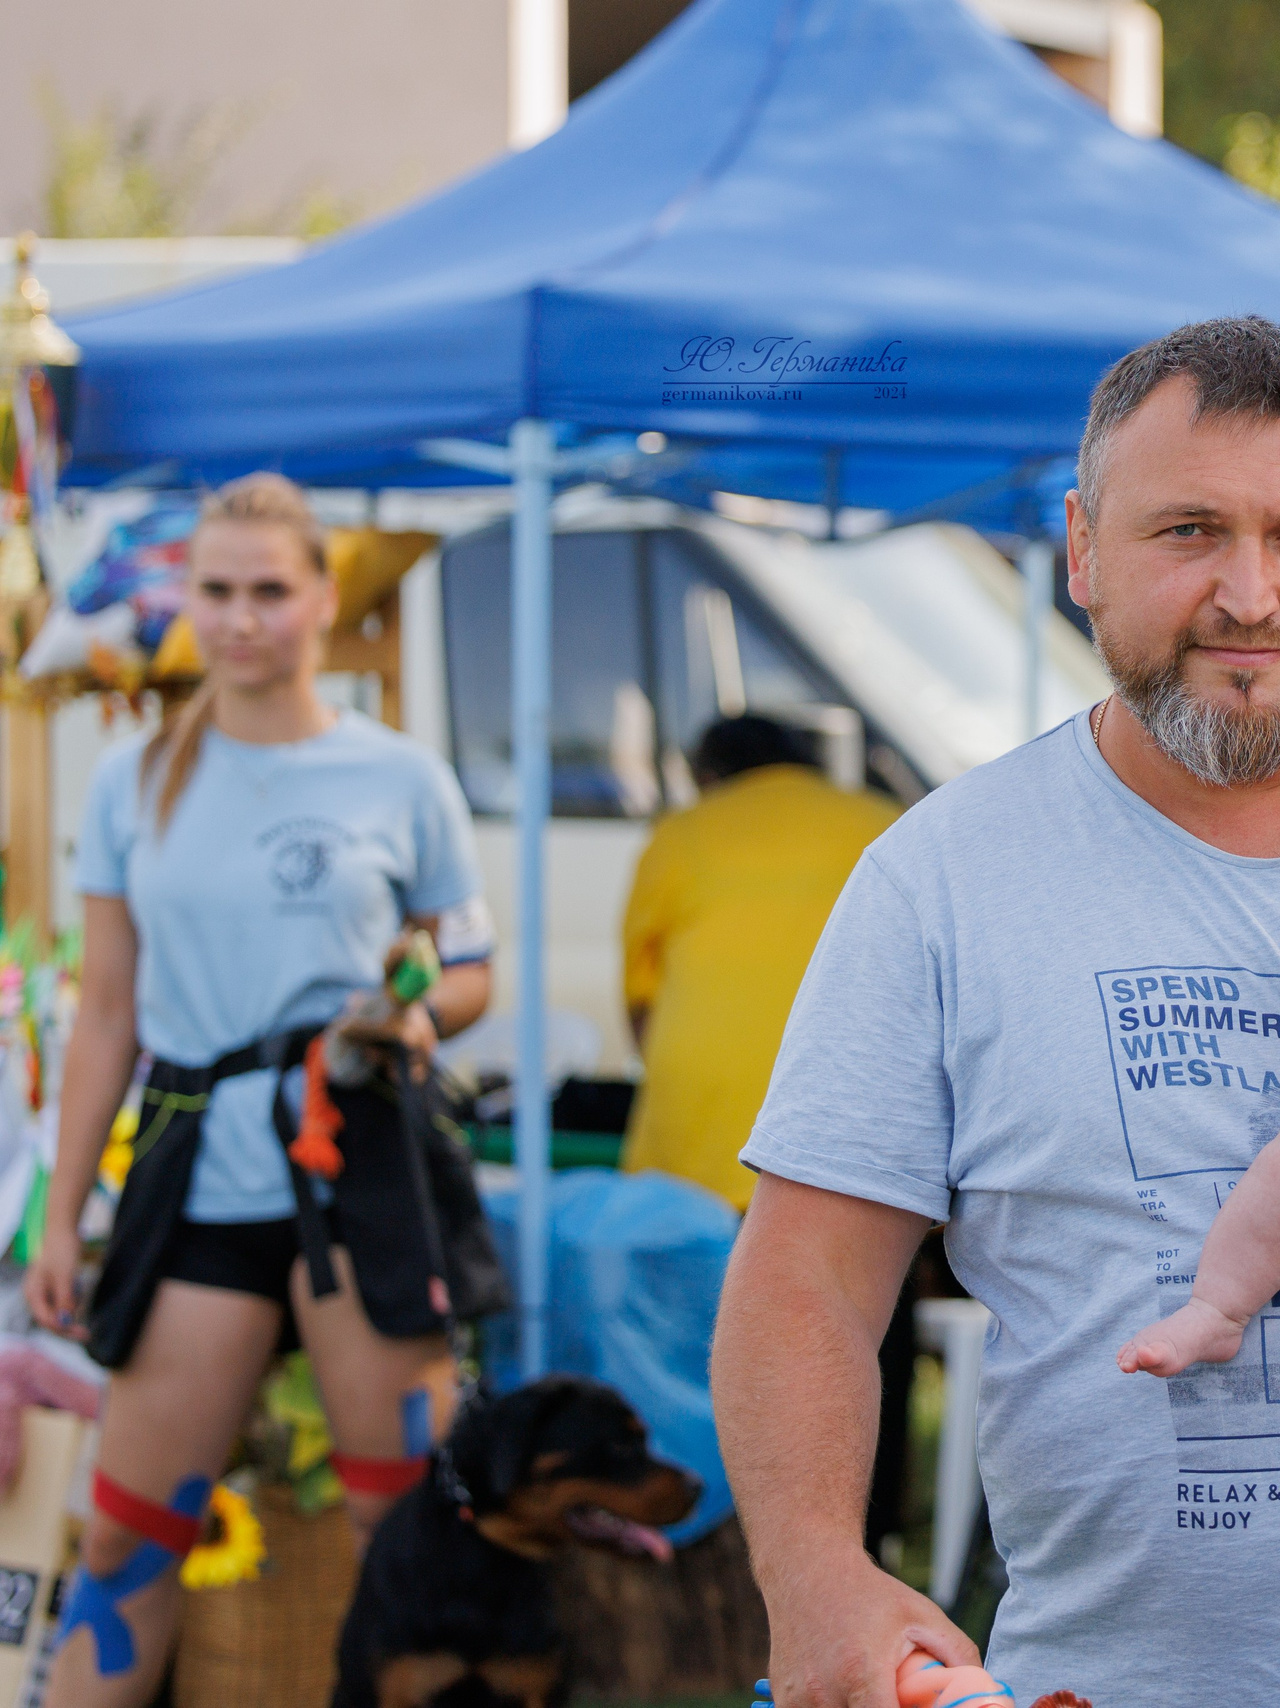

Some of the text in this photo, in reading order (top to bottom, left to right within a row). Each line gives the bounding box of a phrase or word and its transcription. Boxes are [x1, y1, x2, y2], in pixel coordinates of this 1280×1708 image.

[1111, 975, 1240, 1003] SPEND
[1120, 1030, 1221, 1061] WITH
[1137, 1189, 1158, 1199] WE
[1140, 1201, 1167, 1212] TRA
[1156, 1248, 1180, 1259] NOT
[1156, 1262, 1171, 1271] TO
[1177, 1483, 1258, 1503] RELAX
[1177, 1510, 1252, 1530] ENJOY
